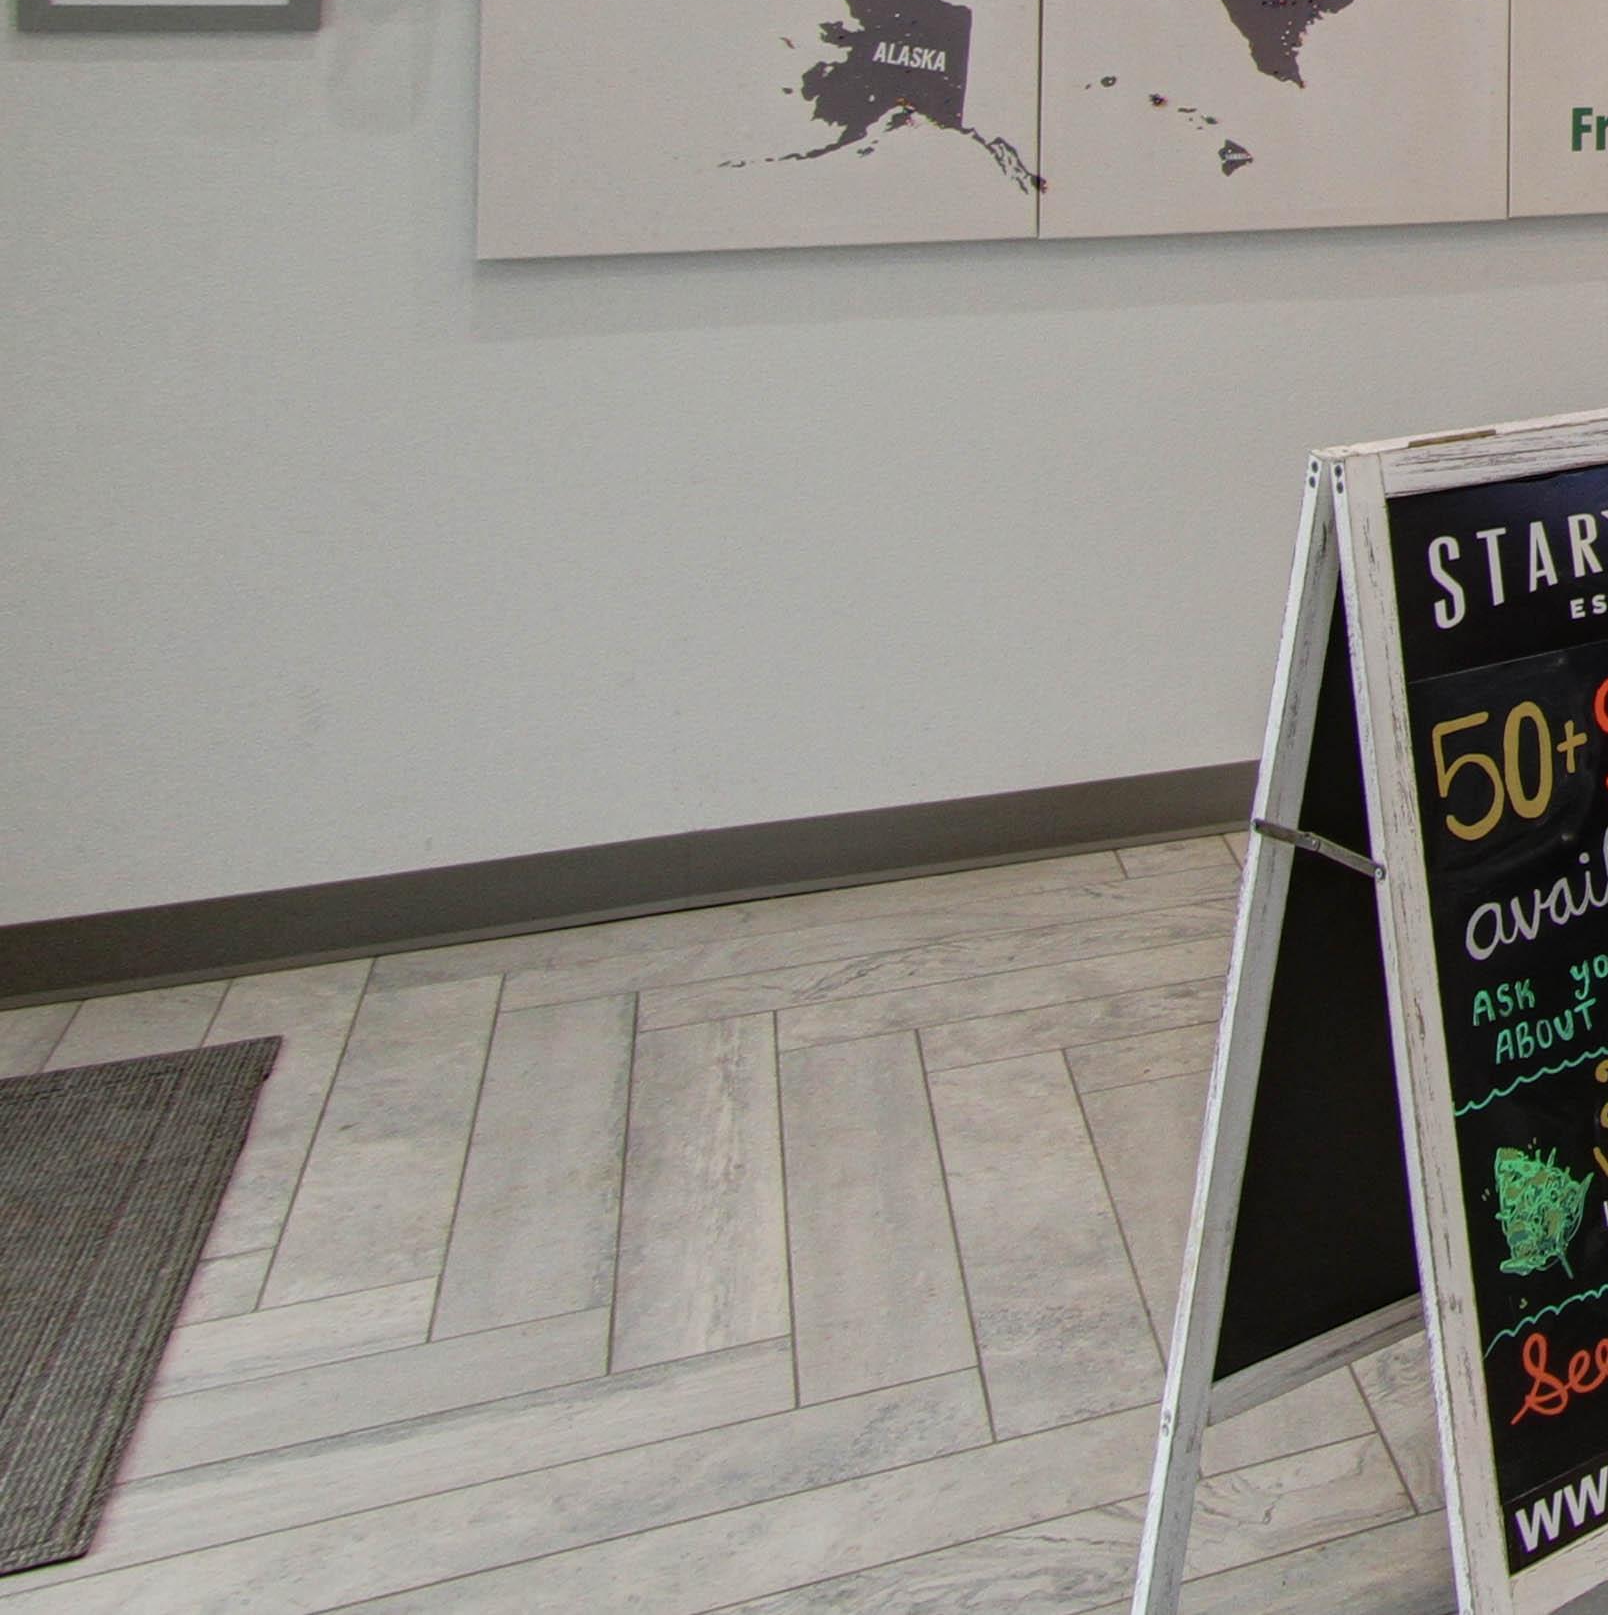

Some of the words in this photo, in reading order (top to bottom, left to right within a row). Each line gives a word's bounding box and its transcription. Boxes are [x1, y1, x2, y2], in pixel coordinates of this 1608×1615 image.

[873, 41, 946, 72] ALASKA
[1427, 512, 1603, 630] STAR
[1431, 700, 1588, 841] 50+
[1473, 978, 1537, 1026] ASK
[1496, 998, 1597, 1064] ABOUT
